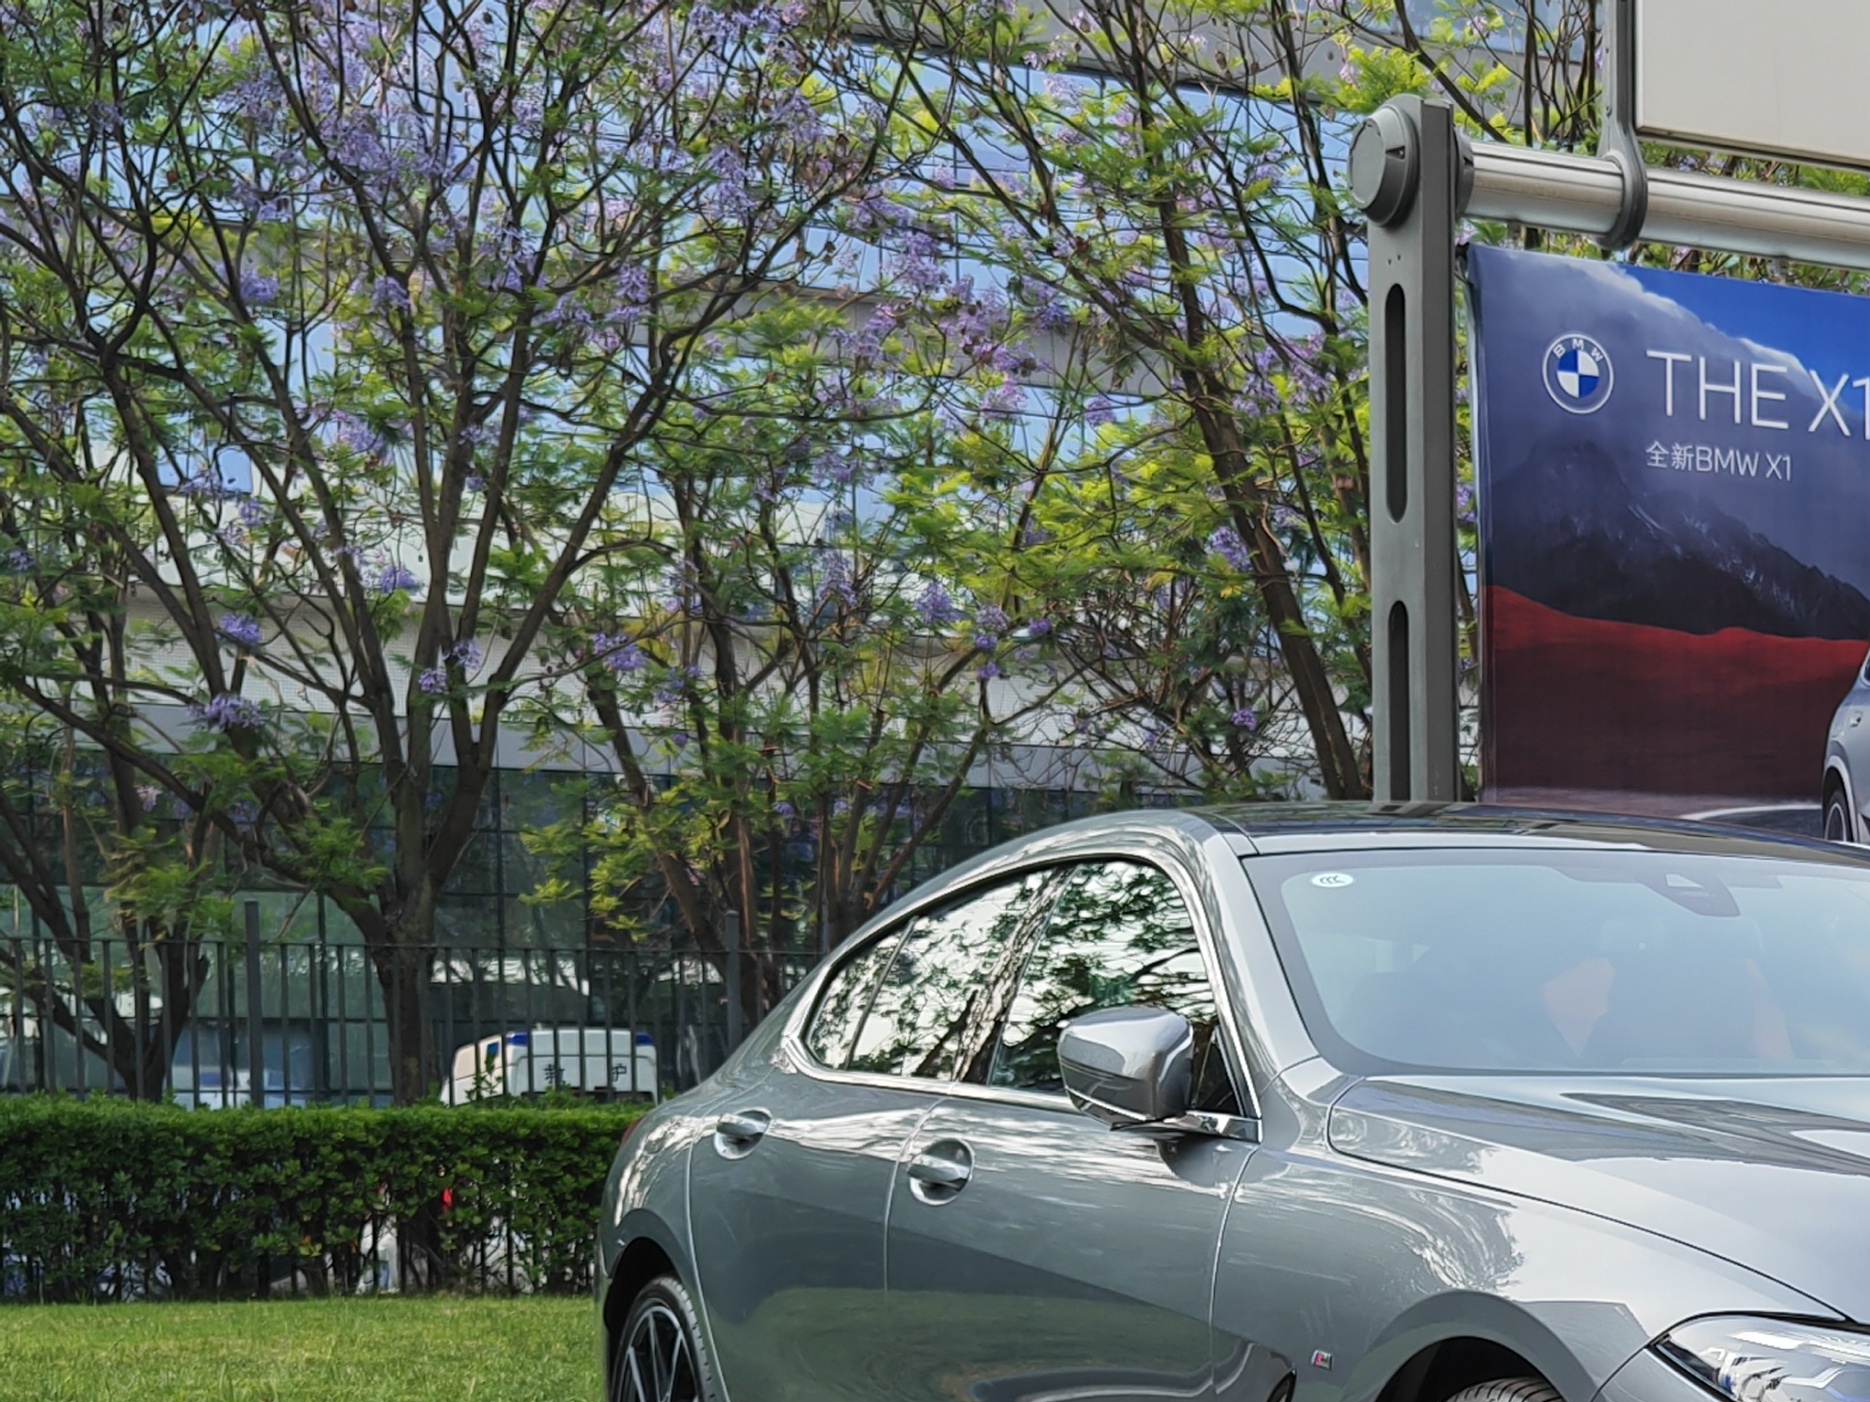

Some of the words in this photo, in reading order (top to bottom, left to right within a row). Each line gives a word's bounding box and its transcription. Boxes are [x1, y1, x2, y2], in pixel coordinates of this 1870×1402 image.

[1552, 338, 1603, 362] BMW
[1646, 349, 1789, 429] THE
[1646, 440, 1759, 477] 全新BMW
[1765, 452, 1791, 481] X1
